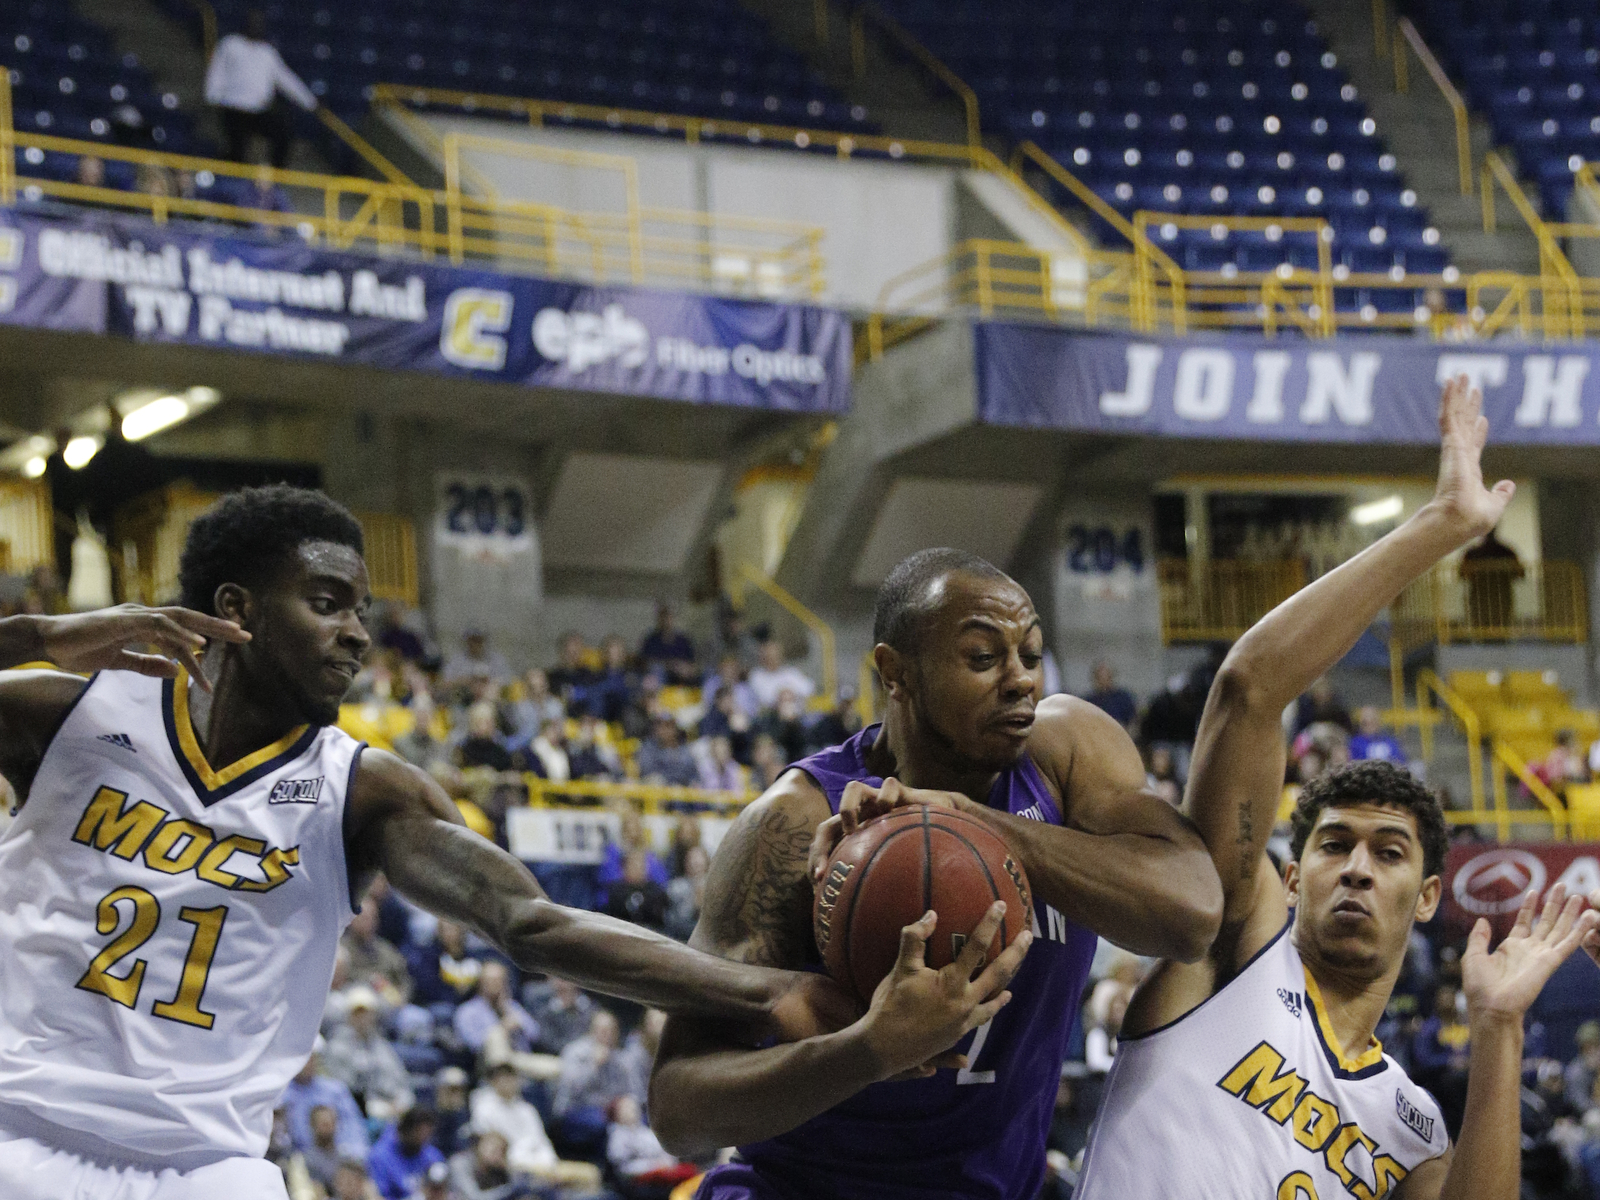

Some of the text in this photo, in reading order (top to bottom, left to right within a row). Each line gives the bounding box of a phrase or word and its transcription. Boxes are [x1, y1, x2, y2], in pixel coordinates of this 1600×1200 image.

[125, 286, 350, 356] TV Partner
[187, 248, 345, 312] Internet
[349, 269, 427, 322] And
[532, 303, 649, 374] epb
[731, 343, 826, 388] Optics
[1100, 343, 1600, 429] JOIN TH
[269, 776, 325, 804] SOCON
[71, 785, 300, 893] MOCS
[75, 885, 229, 1030] 21
